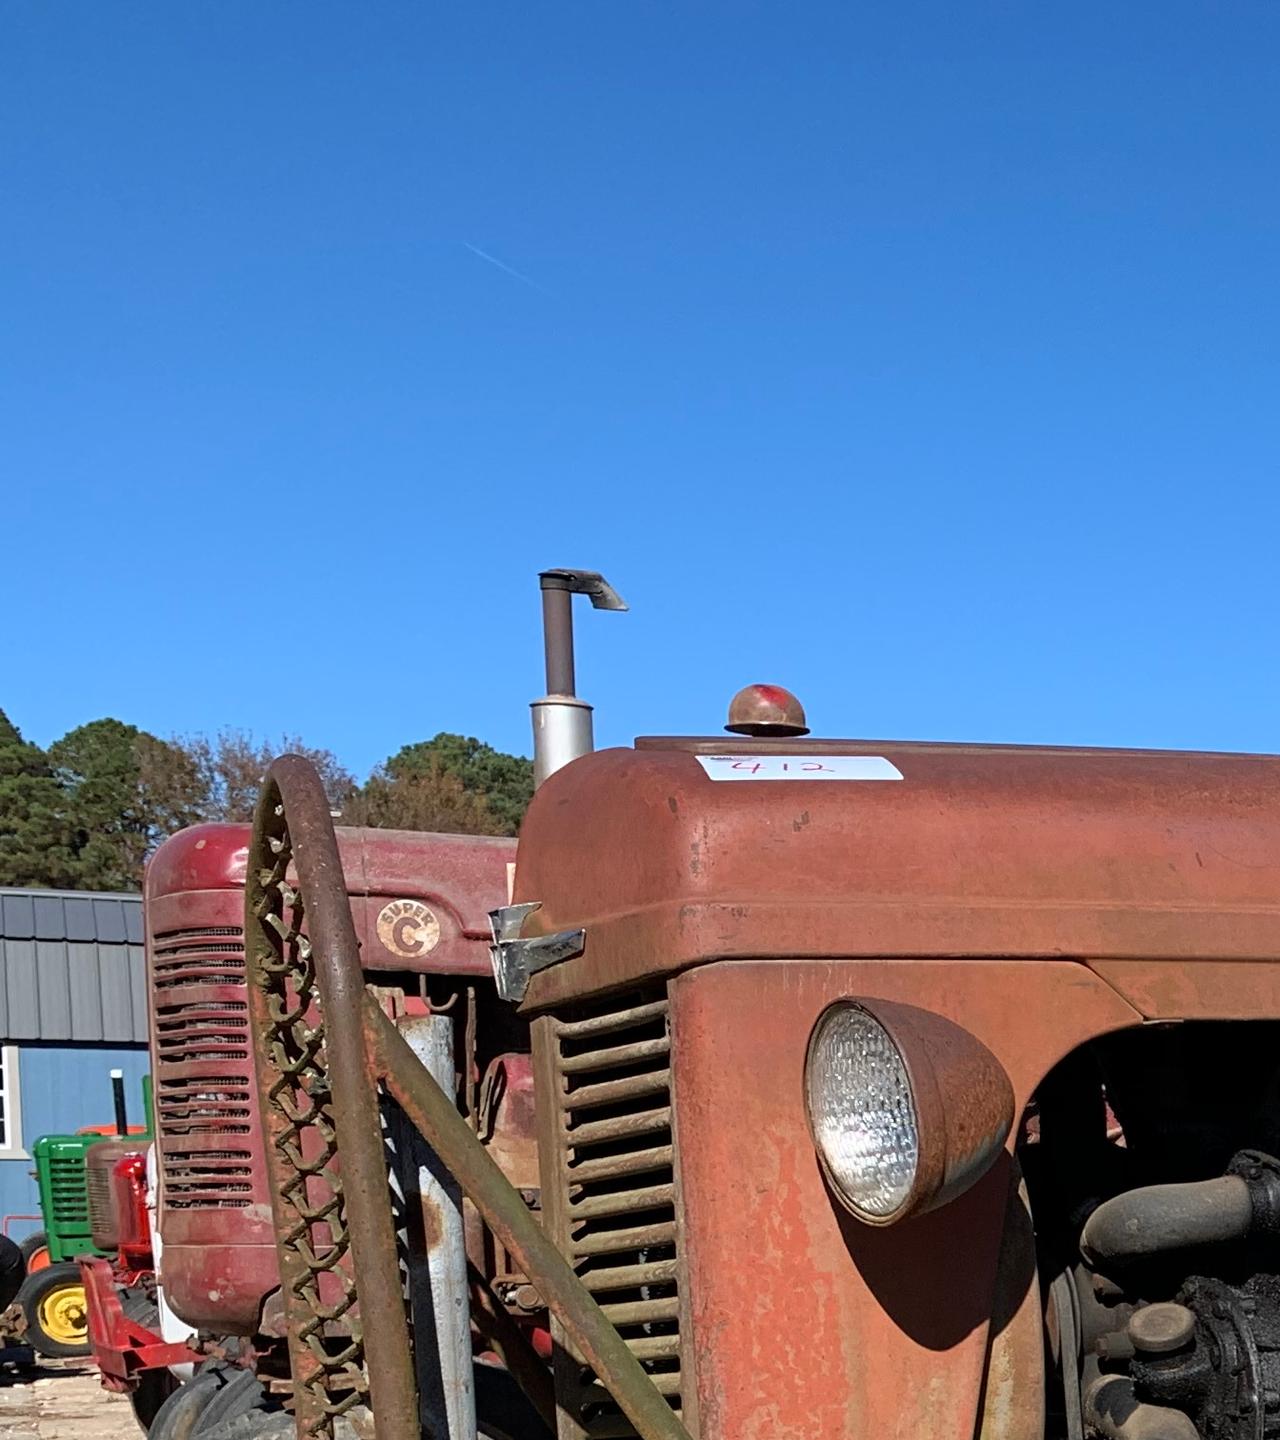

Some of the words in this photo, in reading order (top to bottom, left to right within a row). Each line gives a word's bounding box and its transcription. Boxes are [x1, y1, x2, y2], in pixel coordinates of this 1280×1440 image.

[731, 762, 835, 774] 412
[380, 902, 435, 926] SUPER
[392, 916, 425, 953] C
